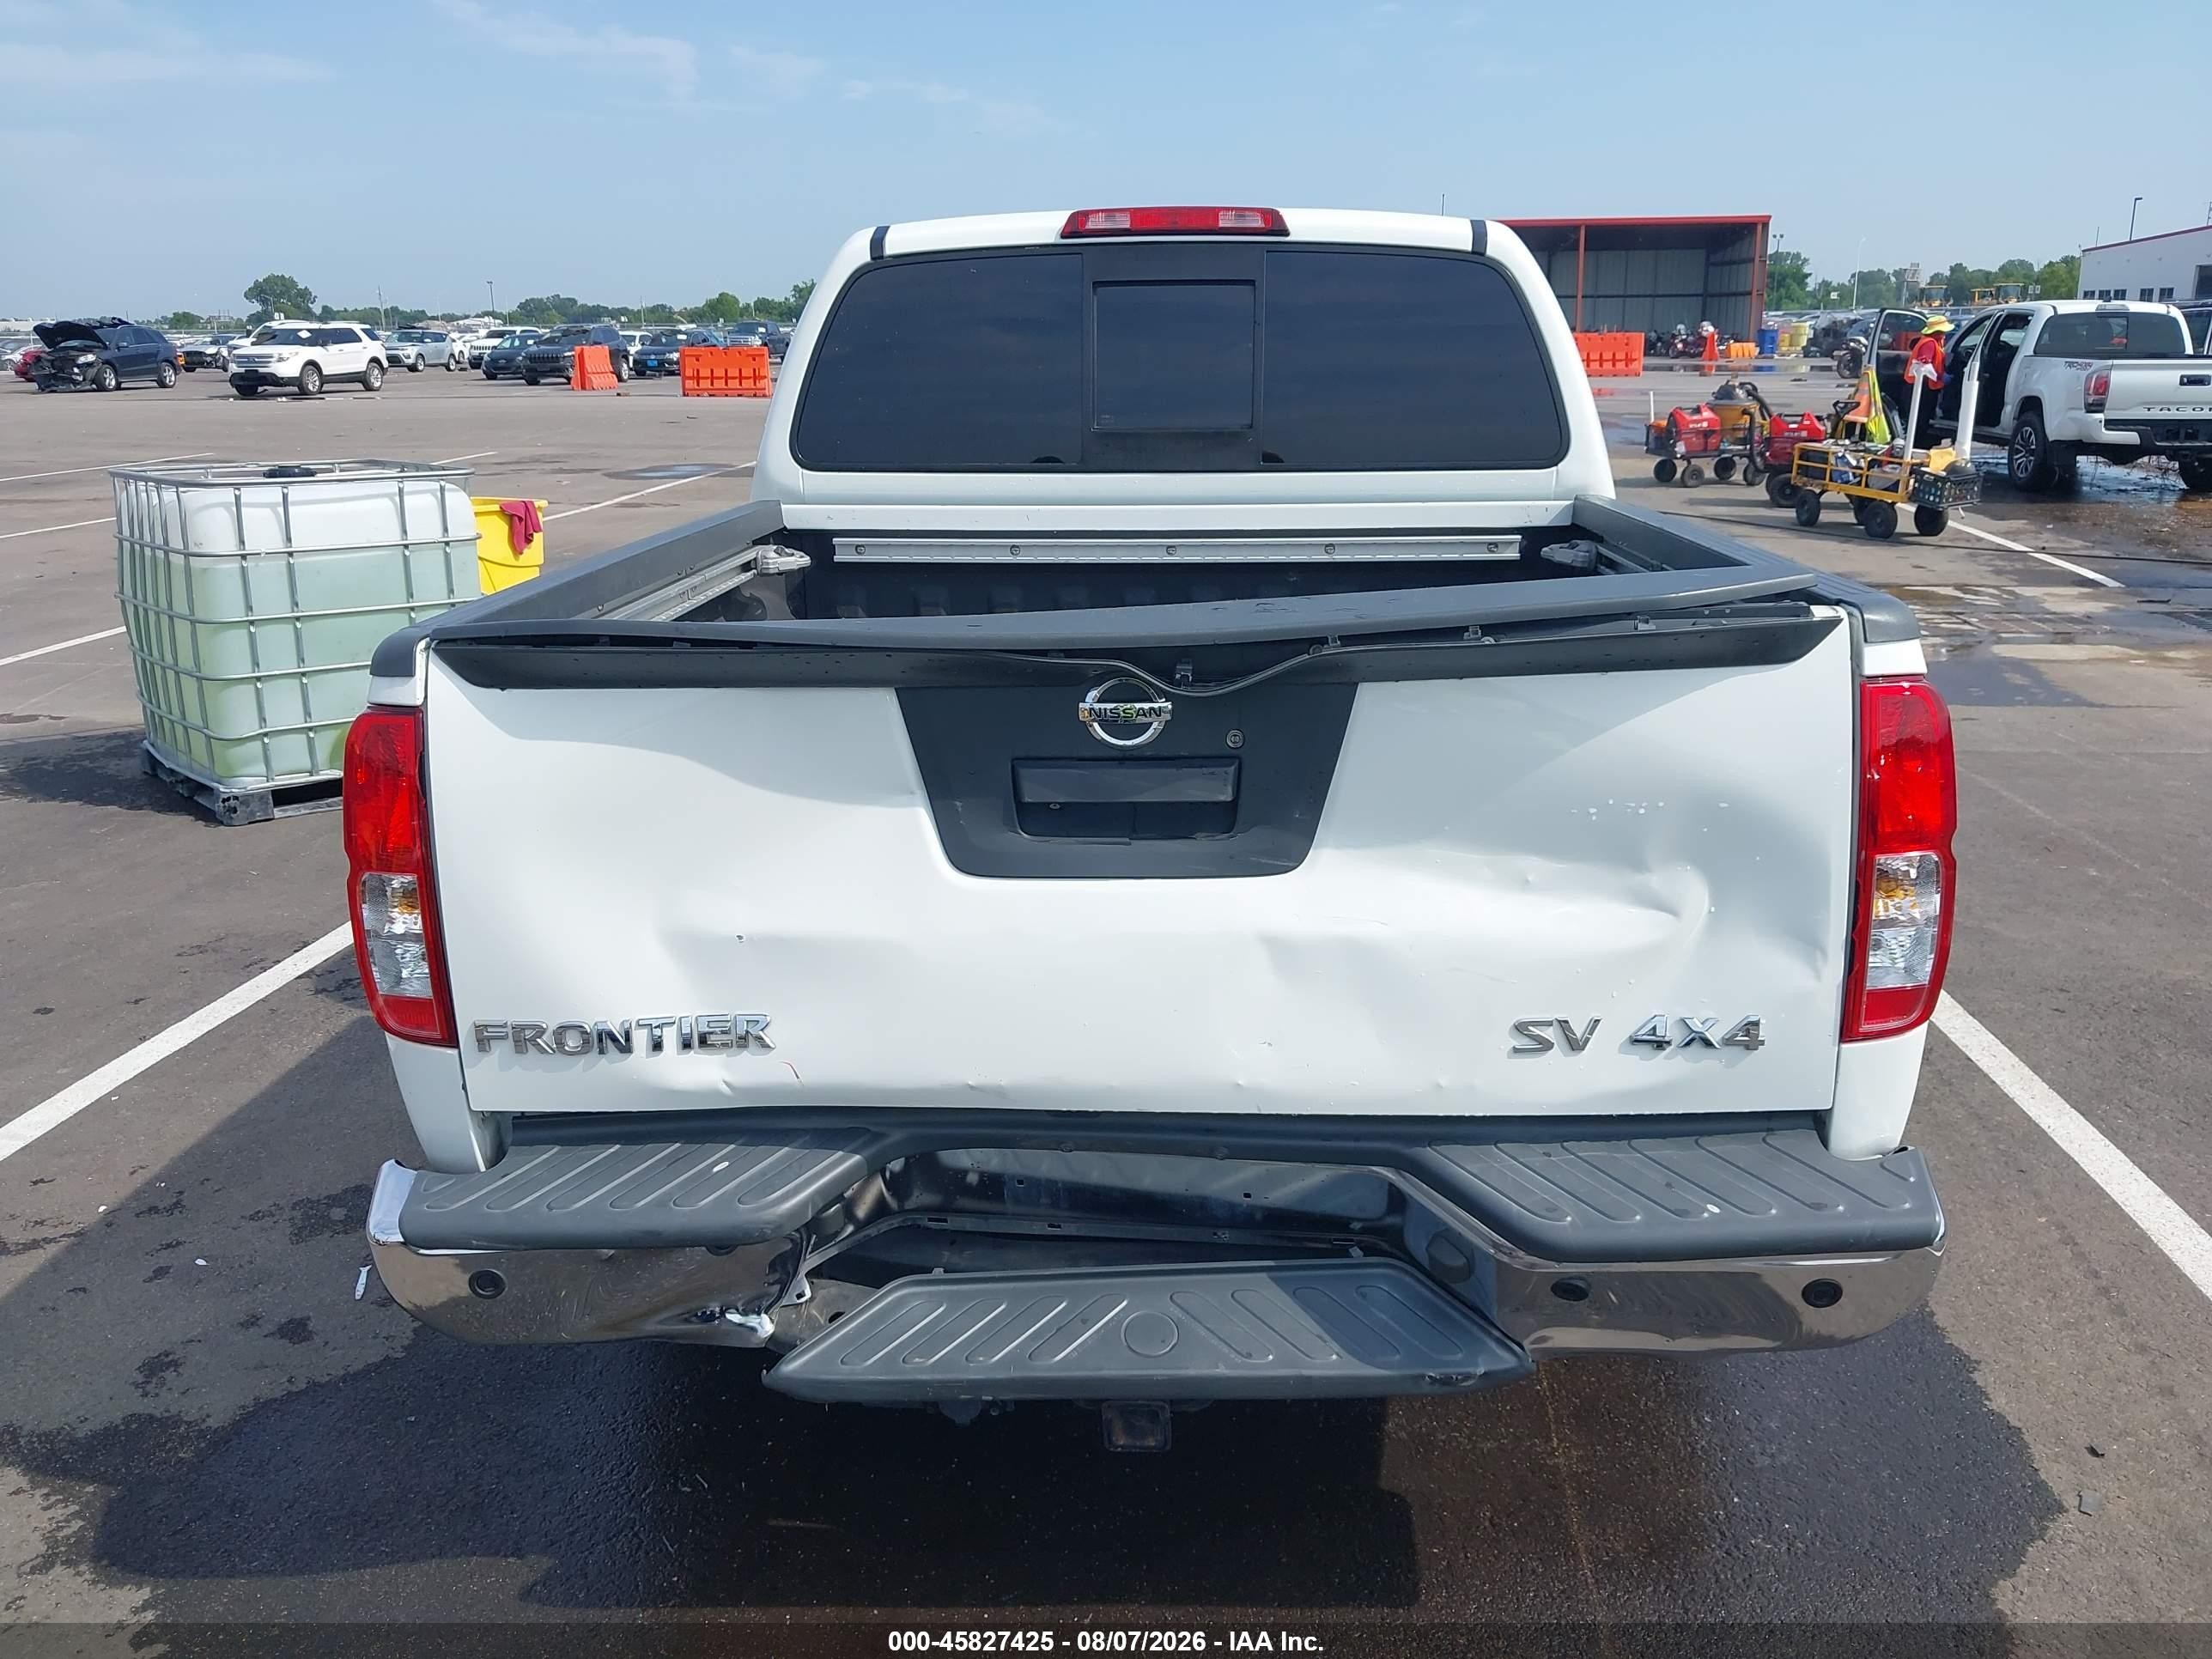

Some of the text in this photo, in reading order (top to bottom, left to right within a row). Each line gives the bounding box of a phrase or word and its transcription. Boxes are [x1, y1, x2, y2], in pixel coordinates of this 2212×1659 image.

[1089, 706, 1162, 719] NISSAN
[473, 1012, 776, 1055] FRONTIER
[1512, 1015, 1603, 1053] SV
